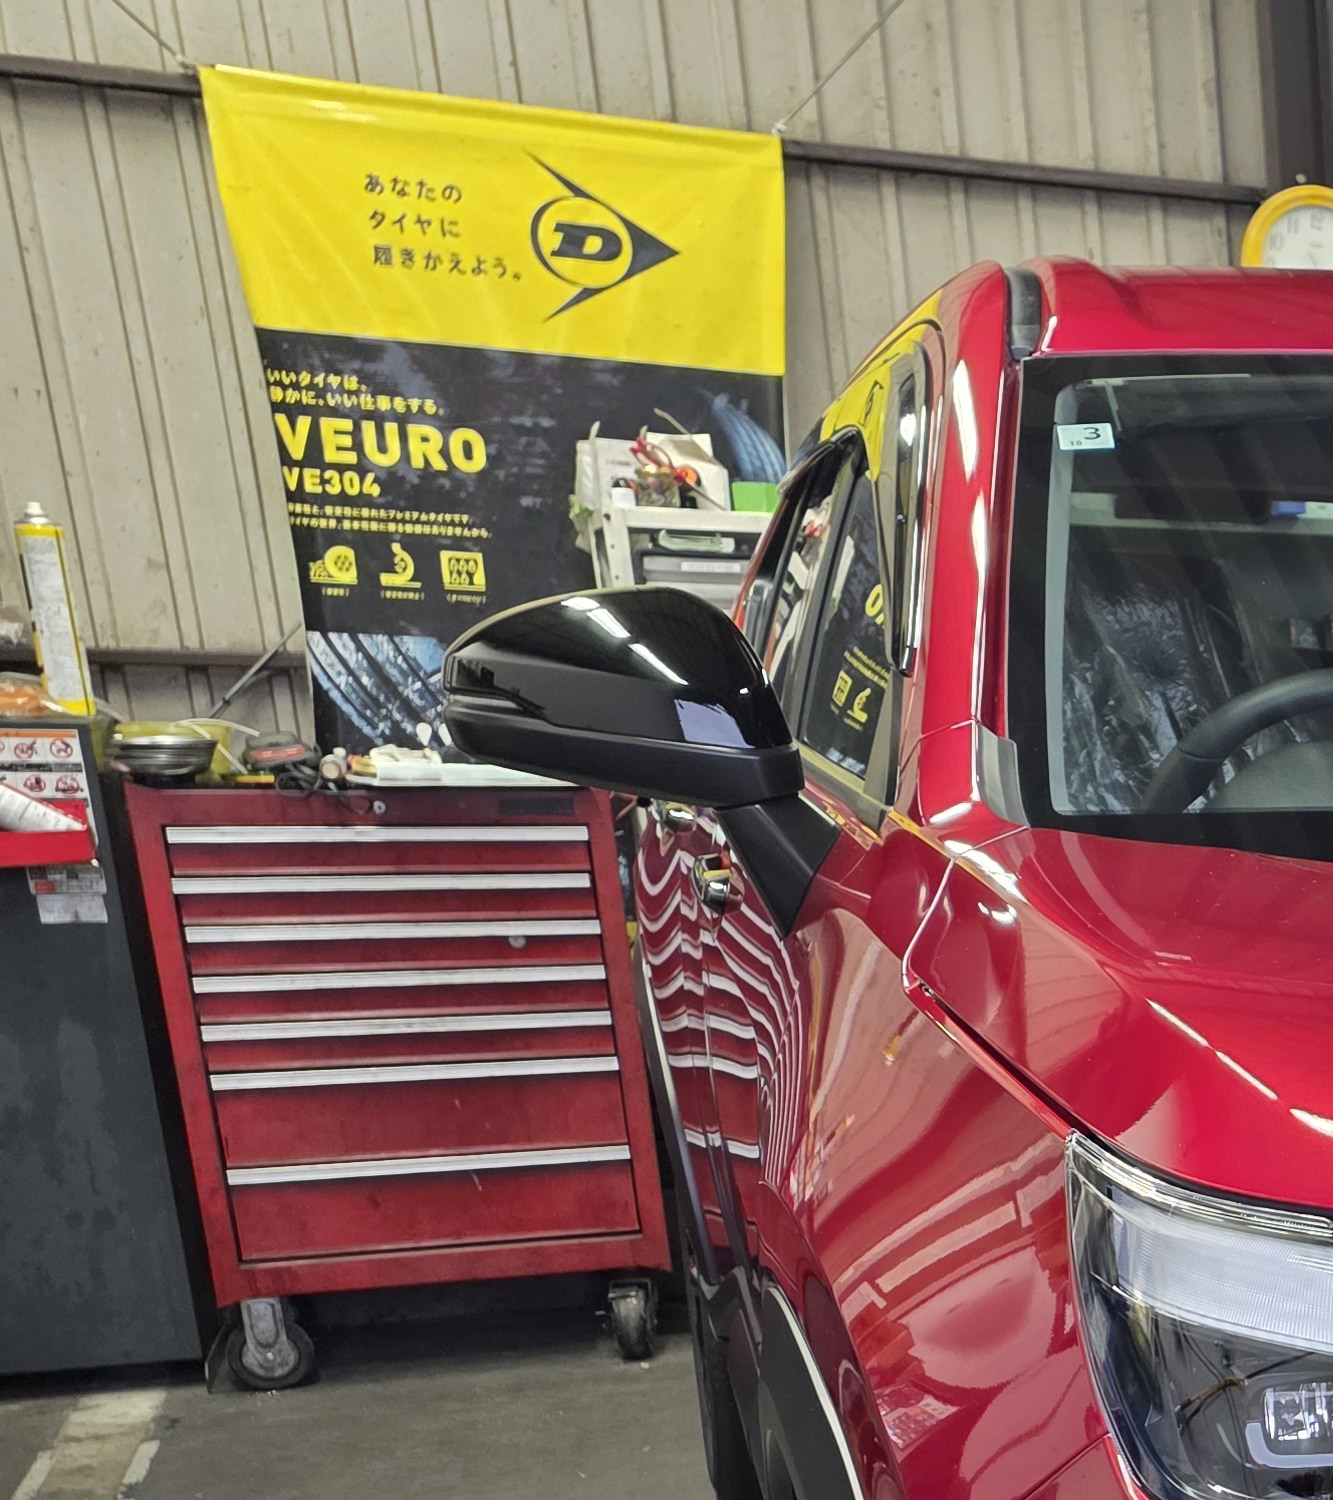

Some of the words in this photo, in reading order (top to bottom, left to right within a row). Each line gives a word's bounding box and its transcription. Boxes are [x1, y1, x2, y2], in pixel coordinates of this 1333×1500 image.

[364, 172, 462, 203] あなたの
[369, 209, 461, 238] タイヤに
[373, 243, 522, 282] 履きかえよう。
[274, 413, 487, 473] VEURO
[1083, 427, 1101, 440] 3
[283, 466, 381, 497] VE304
